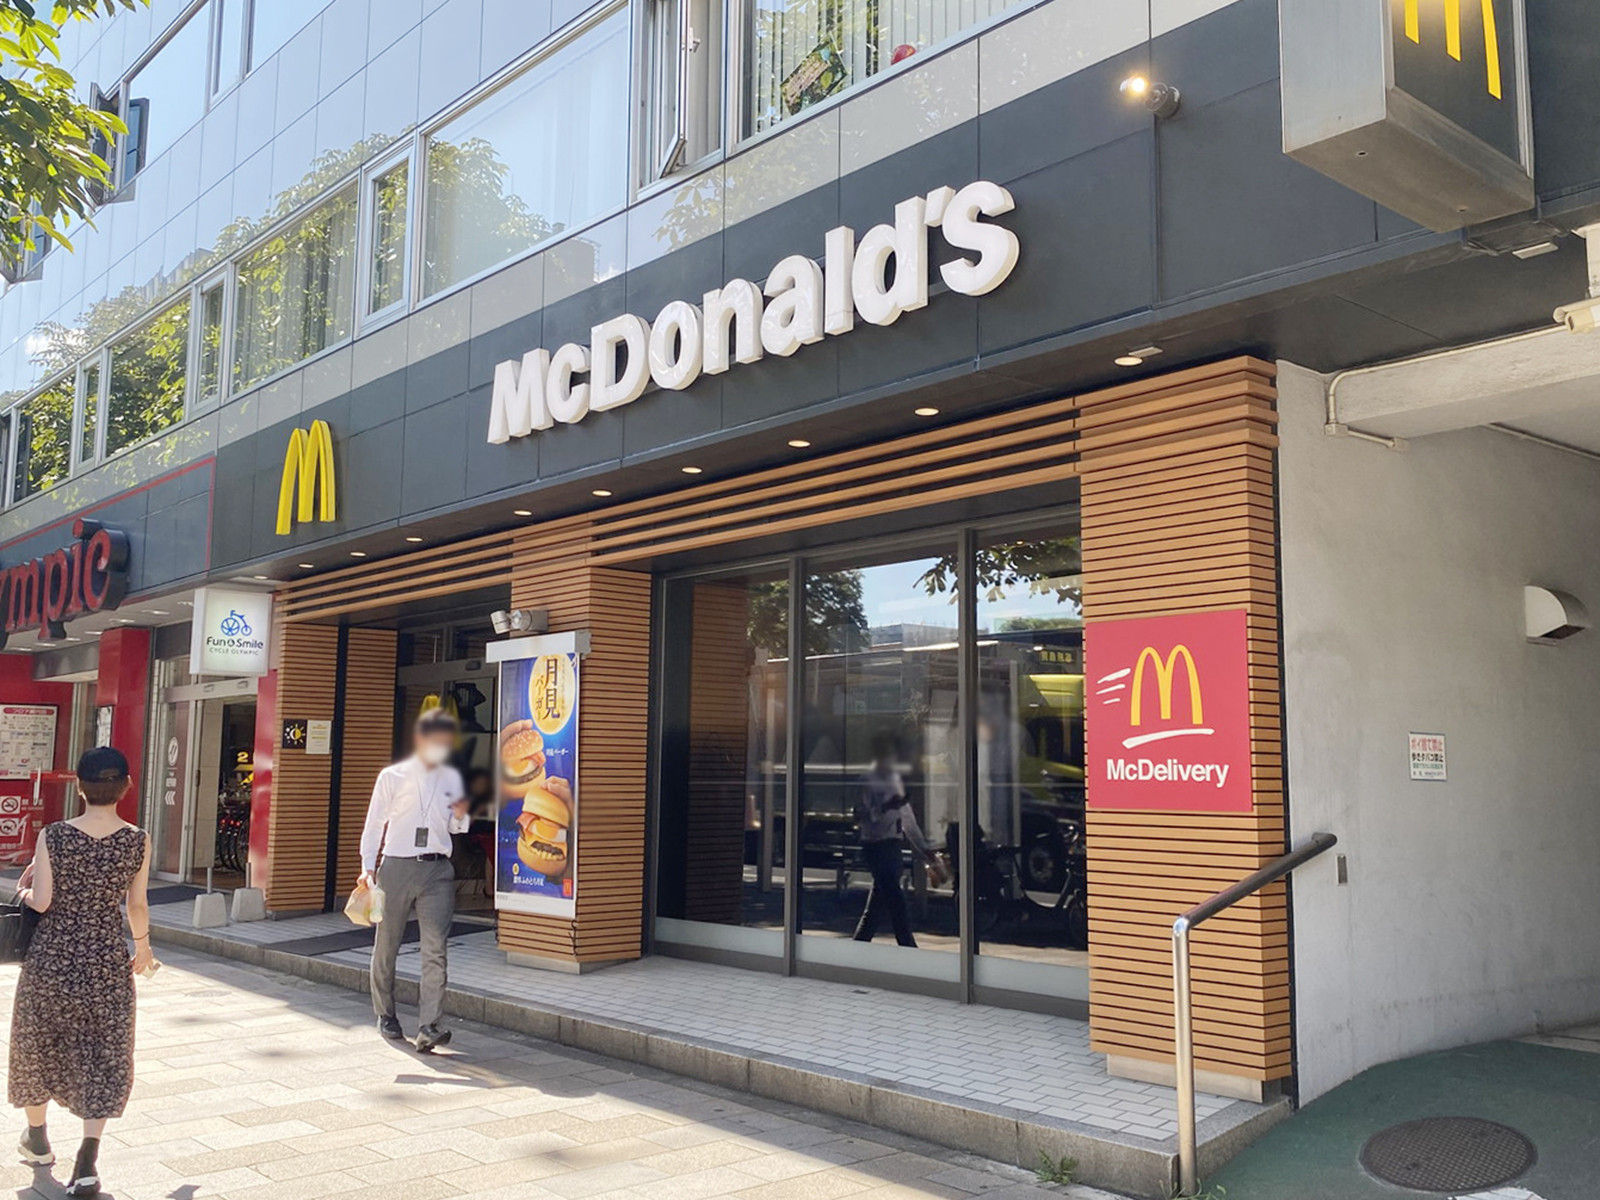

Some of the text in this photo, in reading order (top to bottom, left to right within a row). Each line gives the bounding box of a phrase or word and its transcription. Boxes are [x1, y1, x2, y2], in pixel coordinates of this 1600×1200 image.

[487, 180, 1021, 445] McDonald's
[0, 517, 130, 640] mpic
[543, 658, 560, 720] 月見
[1106, 758, 1230, 788] McDelivery
